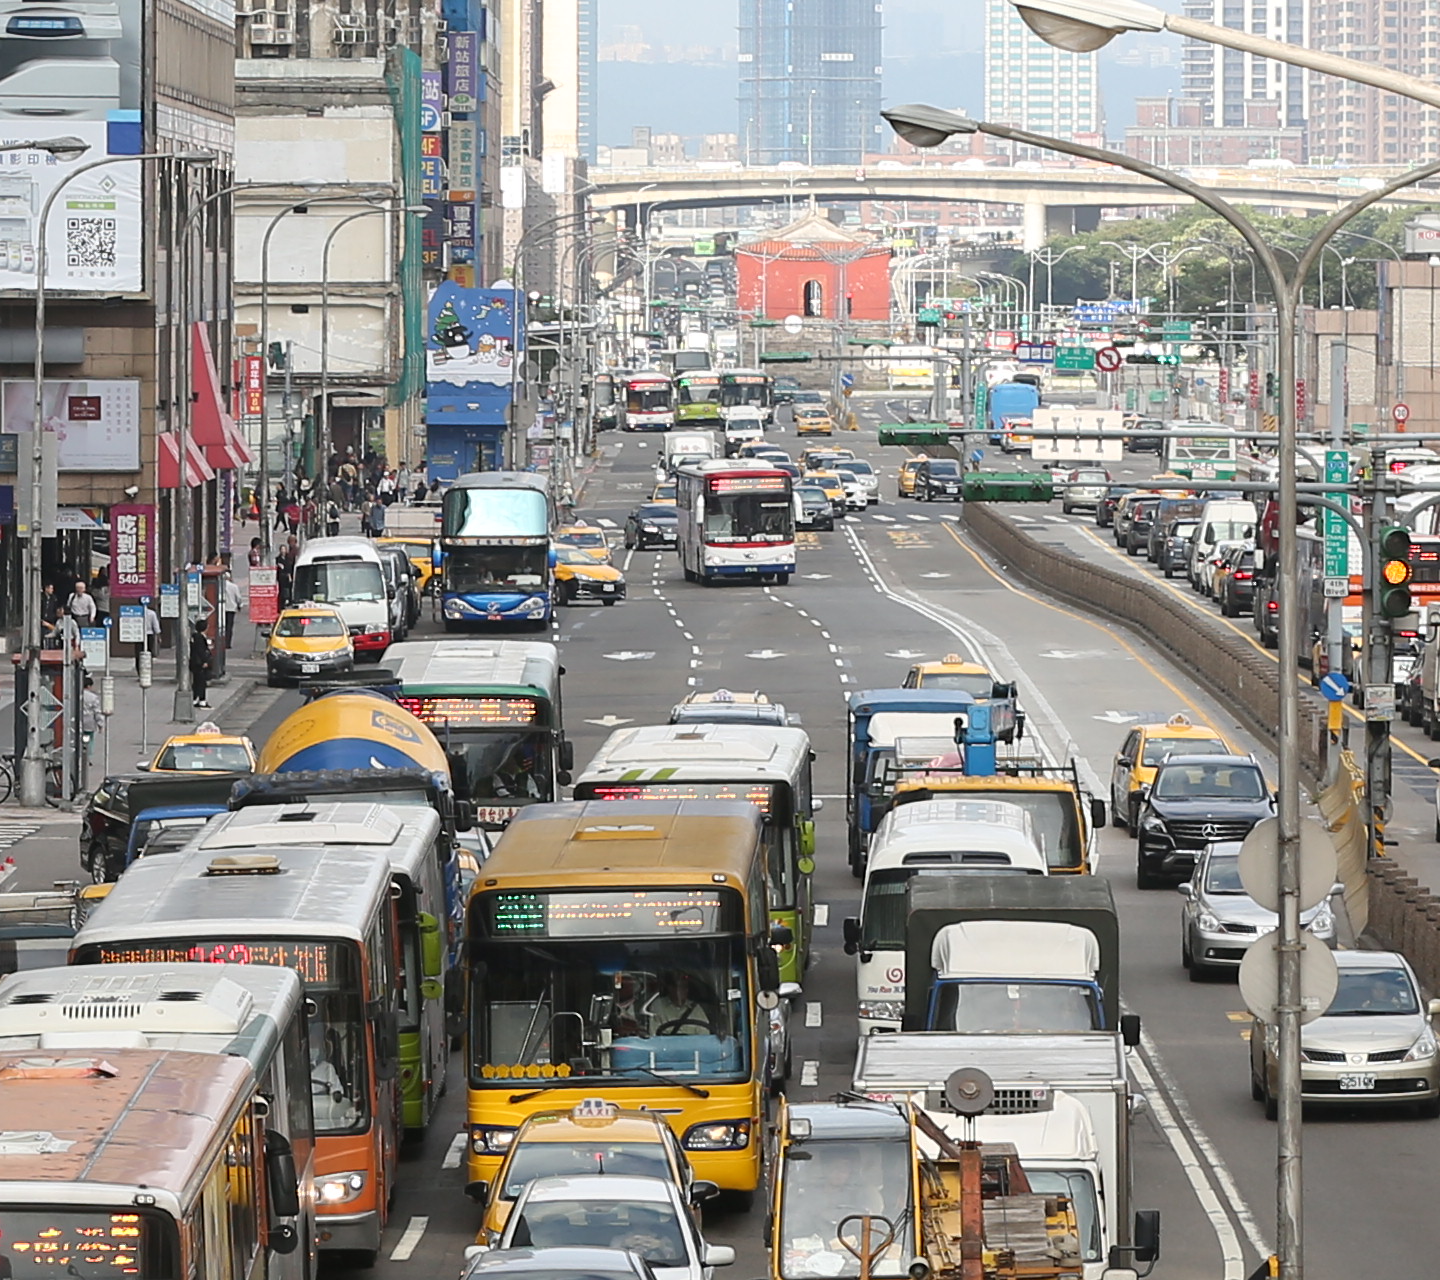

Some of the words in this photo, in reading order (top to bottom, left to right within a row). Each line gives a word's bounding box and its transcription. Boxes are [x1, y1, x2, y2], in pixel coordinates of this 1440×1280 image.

[454, 35, 471, 92] 新站旅店
[117, 515, 137, 573] 吃到飽
[118, 574, 138, 584] 540
